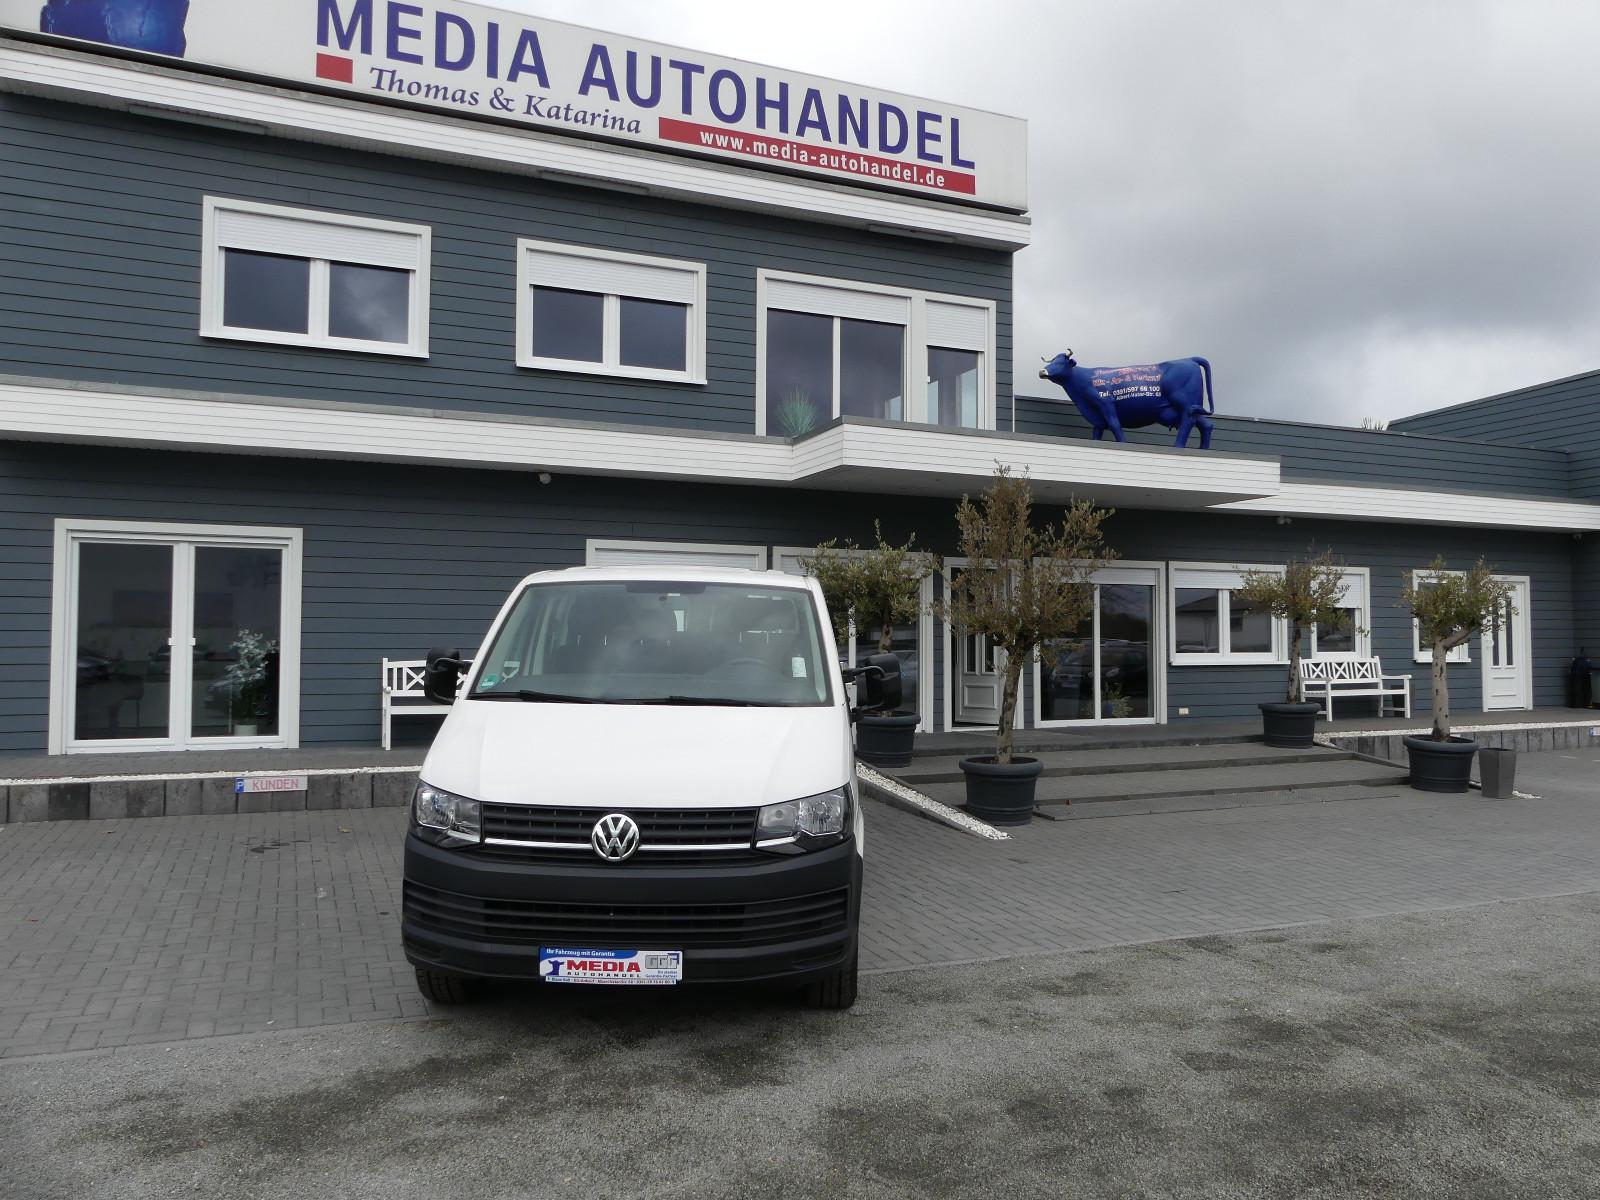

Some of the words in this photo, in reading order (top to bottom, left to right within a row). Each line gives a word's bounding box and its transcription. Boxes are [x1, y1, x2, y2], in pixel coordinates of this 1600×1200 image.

[316, 0, 551, 90] MEDIA
[577, 43, 976, 170] AUTOHANDEL
[370, 66, 480, 107] Thomas
[489, 87, 516, 113] &
[522, 94, 642, 135] Katarina
[700, 130, 946, 188] www.media-autohandel.de
[237, 781, 243, 790] P
[252, 778, 299, 791] KUNDEN
[555, 948, 580, 957] Fahrzeug
[567, 960, 641, 972] MEDIA
